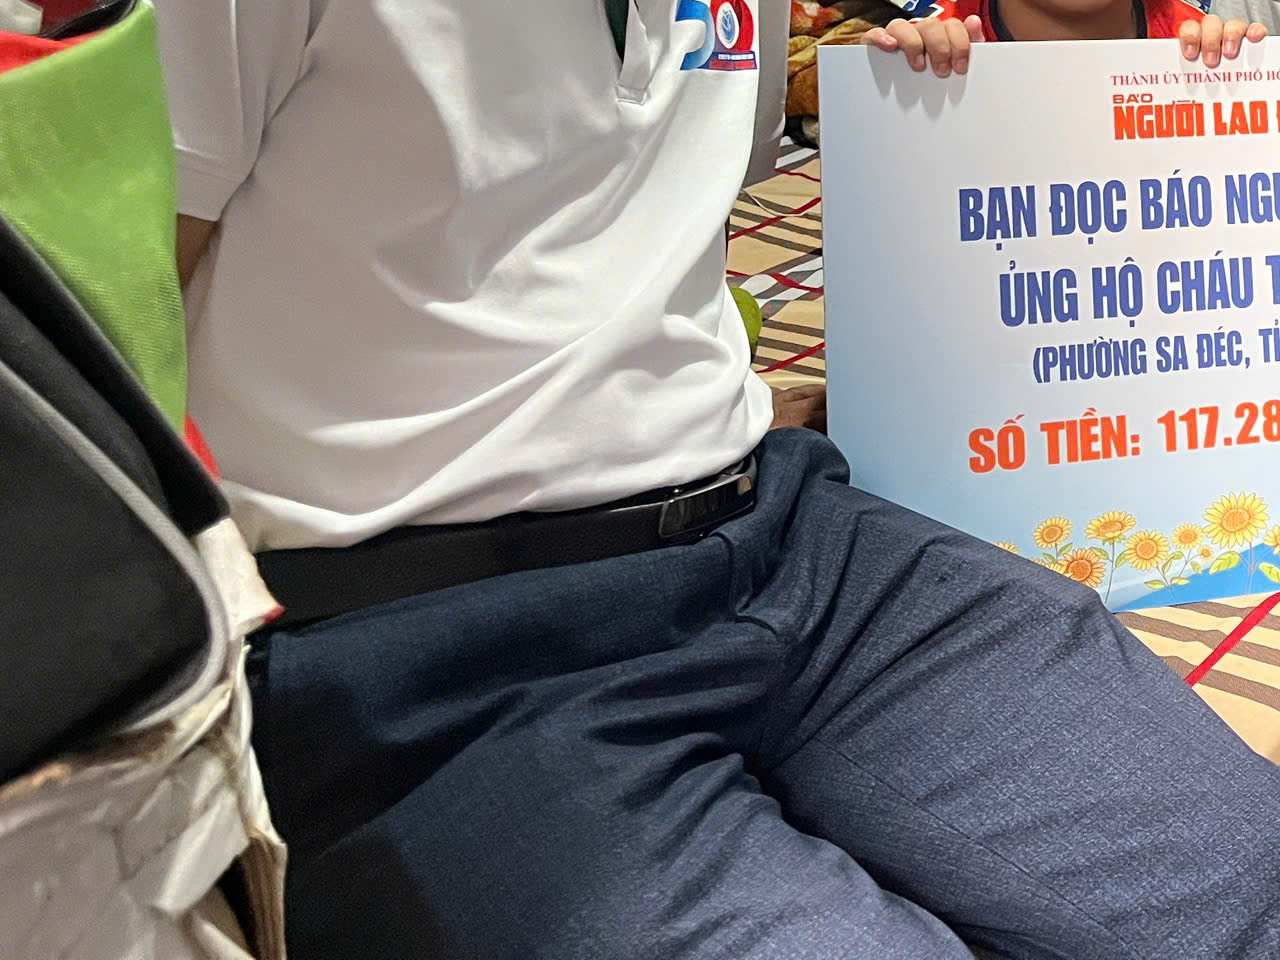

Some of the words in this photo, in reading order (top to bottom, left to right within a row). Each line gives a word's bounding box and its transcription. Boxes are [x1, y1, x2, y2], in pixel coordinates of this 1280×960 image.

[1110, 73, 1159, 86] THÀNH
[1184, 70, 1232, 84] THÀNH
[1235, 67, 1263, 82] PHỐ
[1112, 93, 1153, 104] BÁO
[1113, 99, 1206, 141] NGƯỜI
[1213, 100, 1269, 136] LAO
[958, 185, 1037, 250] BẠN
[1049, 179, 1127, 244] ĐỌC
[1139, 169, 1212, 230] BÁO
[999, 259, 1079, 327] ỦNG
[1092, 256, 1143, 327] HỘ
[1156, 250, 1254, 315] CHÁU
[1033, 336, 1147, 383] (PHƯỜNG
[1156, 335, 1189, 373] SA
[1196, 326, 1251, 369] ĐÉC,
[968, 414, 1027, 474] SỐ
[1040, 407, 1140, 465] TIỀN:
